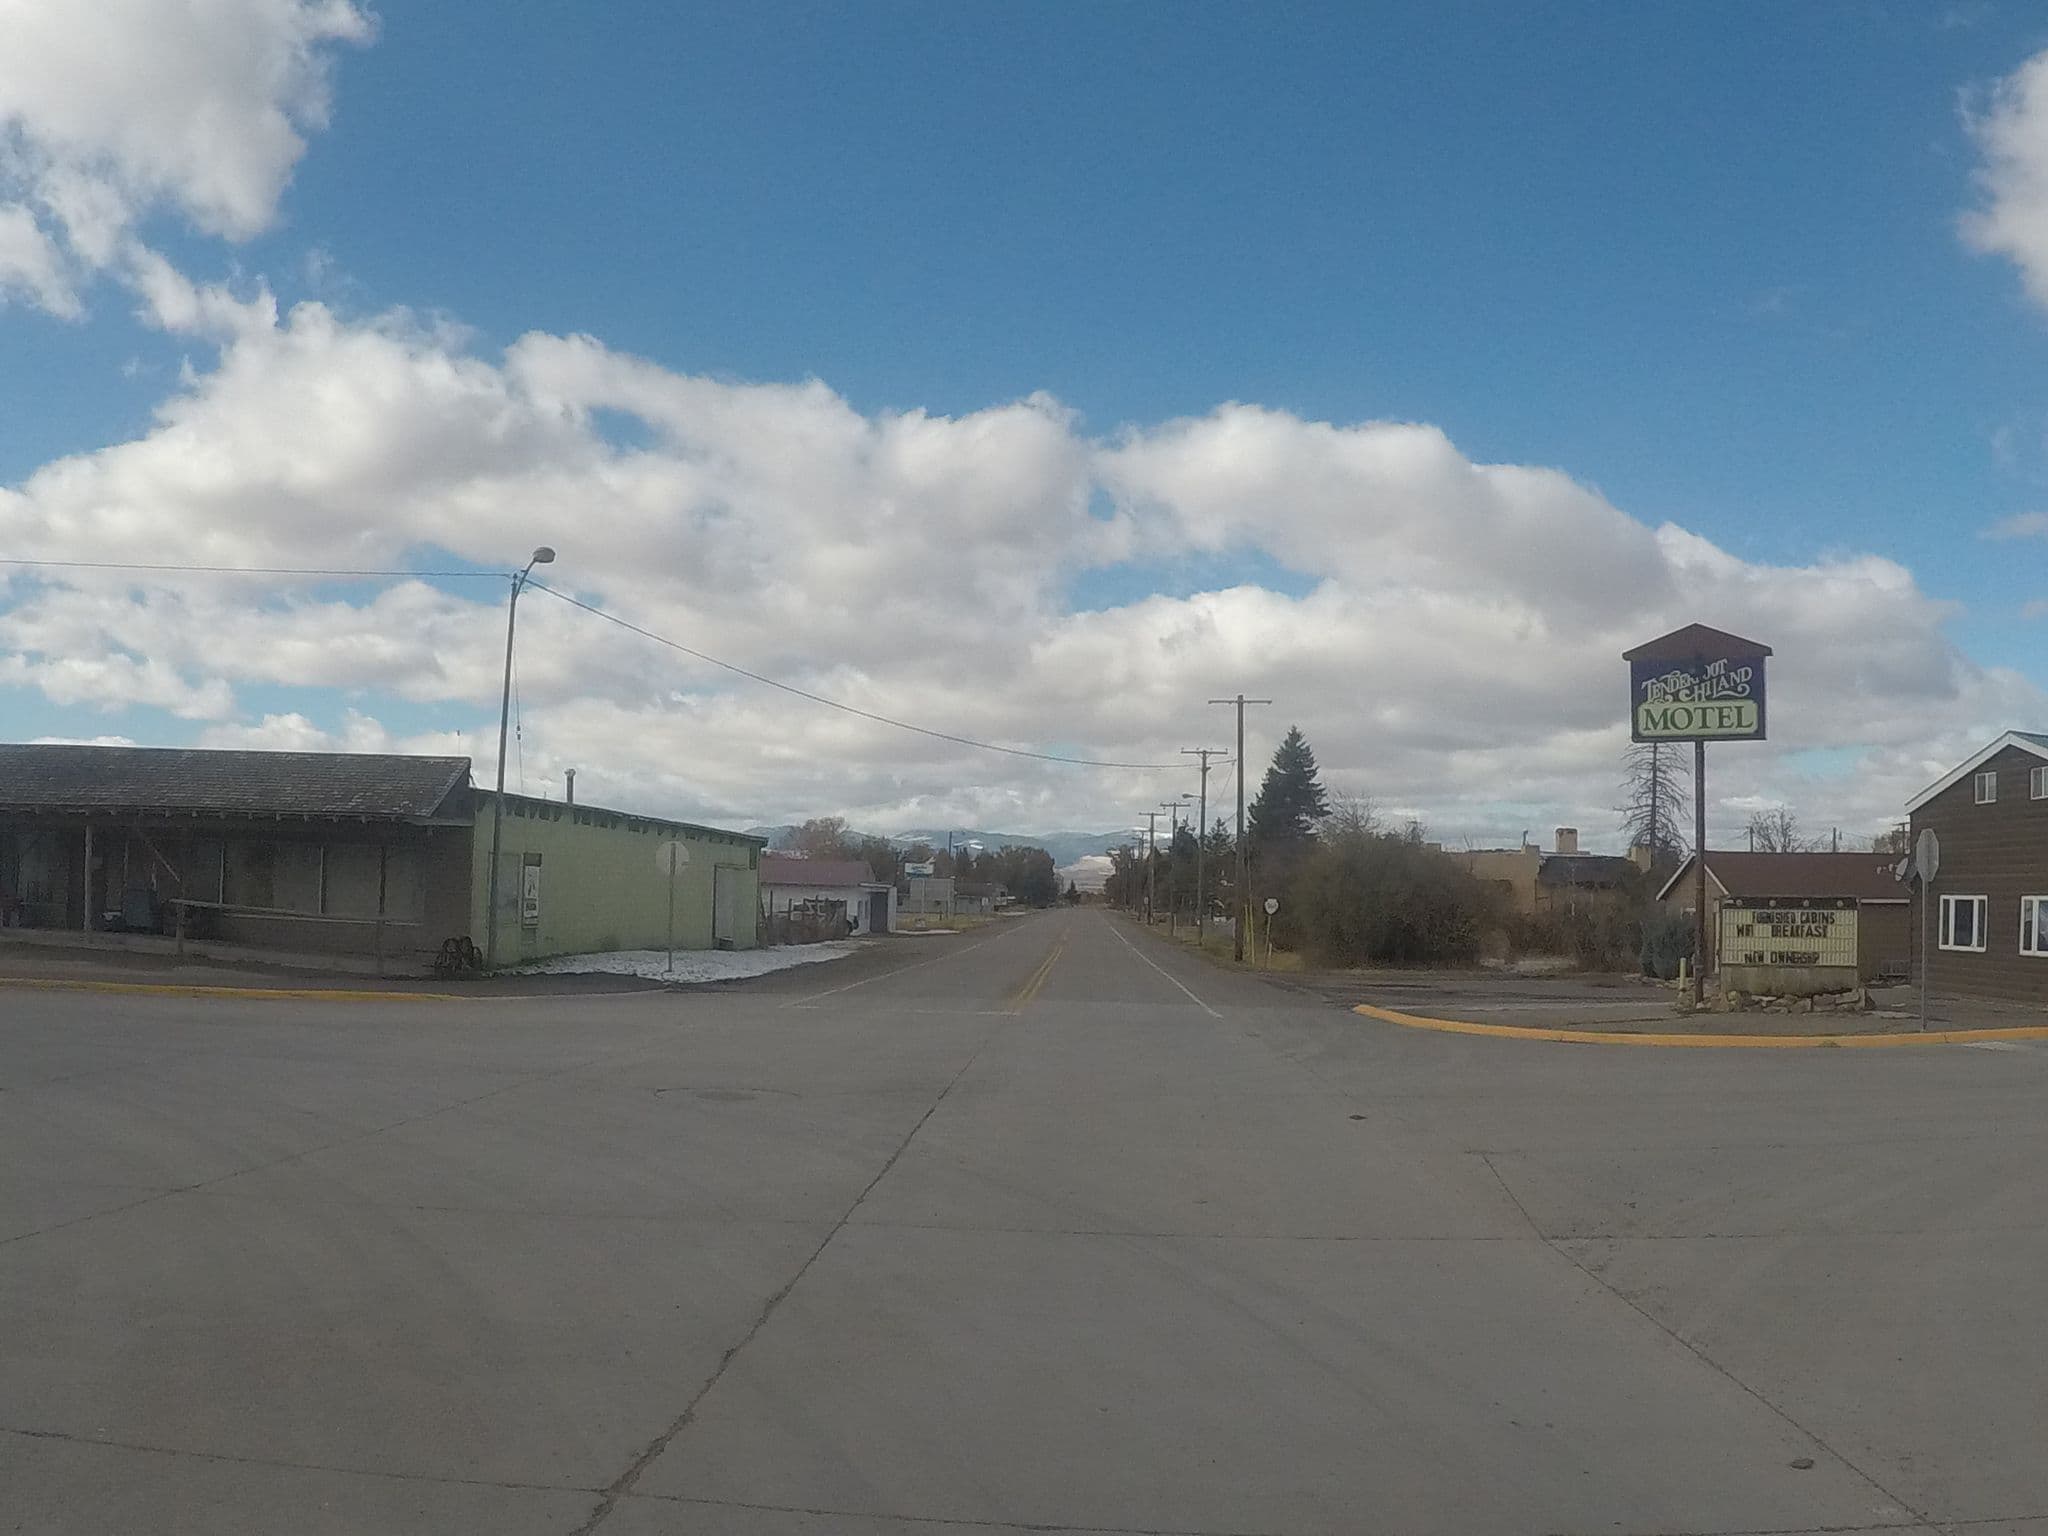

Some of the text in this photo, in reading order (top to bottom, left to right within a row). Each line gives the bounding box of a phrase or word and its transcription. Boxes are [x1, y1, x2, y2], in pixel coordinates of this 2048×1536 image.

[1644, 705, 1754, 731] MOTEL
[1800, 911, 1836, 925] CABINS
[1771, 924, 1829, 938] BREAKFAST
[1744, 951, 1764, 964] NEW
